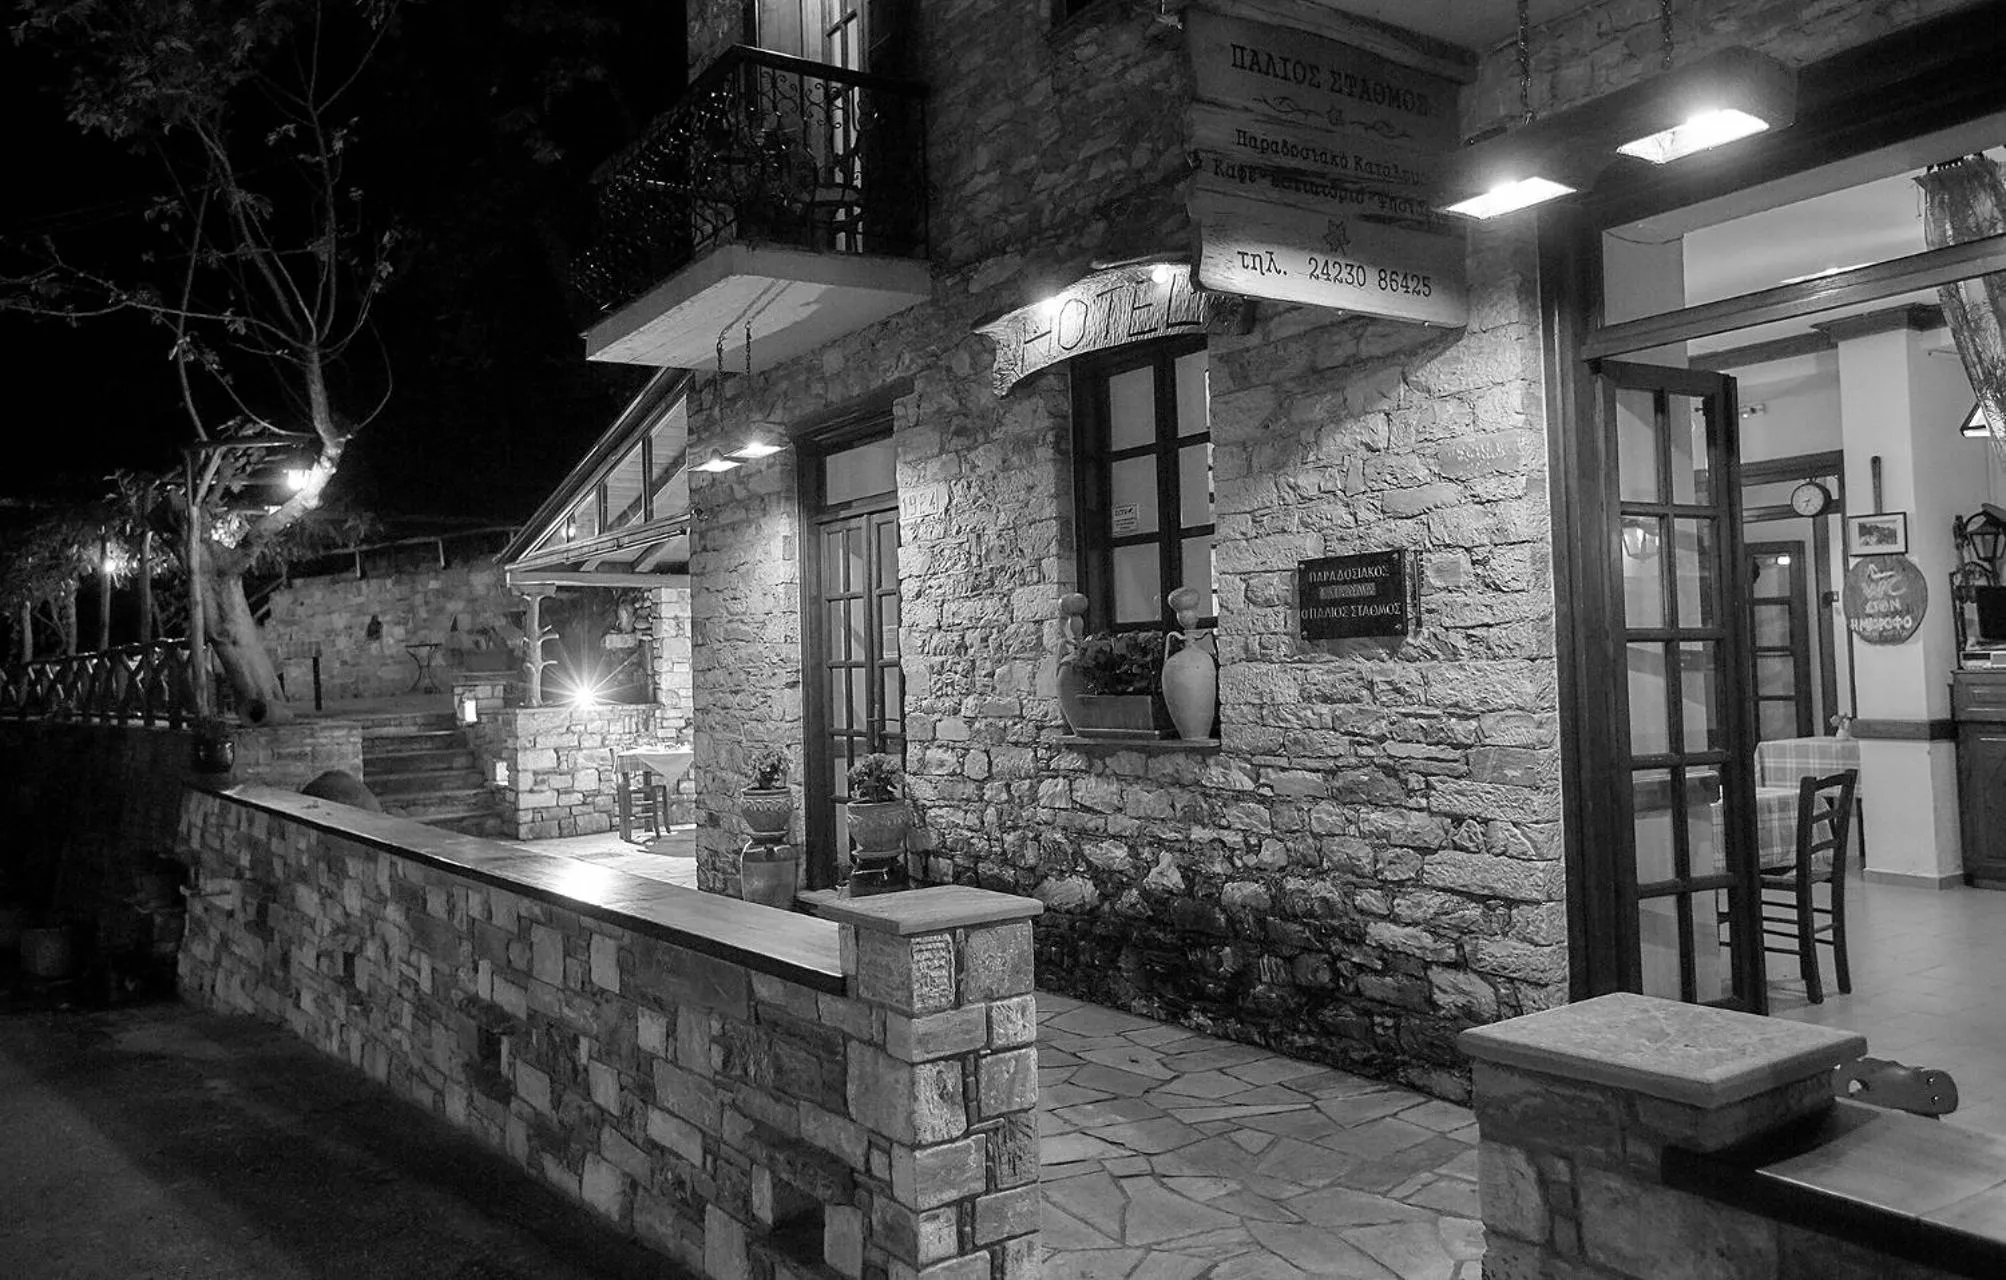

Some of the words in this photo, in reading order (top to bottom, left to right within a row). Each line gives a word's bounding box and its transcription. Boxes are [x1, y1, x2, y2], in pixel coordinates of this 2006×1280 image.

[1230, 43, 1321, 89] ΠΑΛΙΟΣ
[1329, 69, 1430, 117] ΣΤΑΘΜΟΣ
[1237, 250, 1288, 276] τηλ.
[1308, 257, 1366, 287] 24230
[1378, 268, 1432, 297] 86425
[1019, 272, 1202, 374] HOTEL
[1309, 565, 1390, 582] ΠΑΡΑΔΟΣΙΑΚΟΣ
[1861, 577, 1907, 599] WC
[1351, 603, 1401, 618] ΣΤΑΘΜΟΣ
